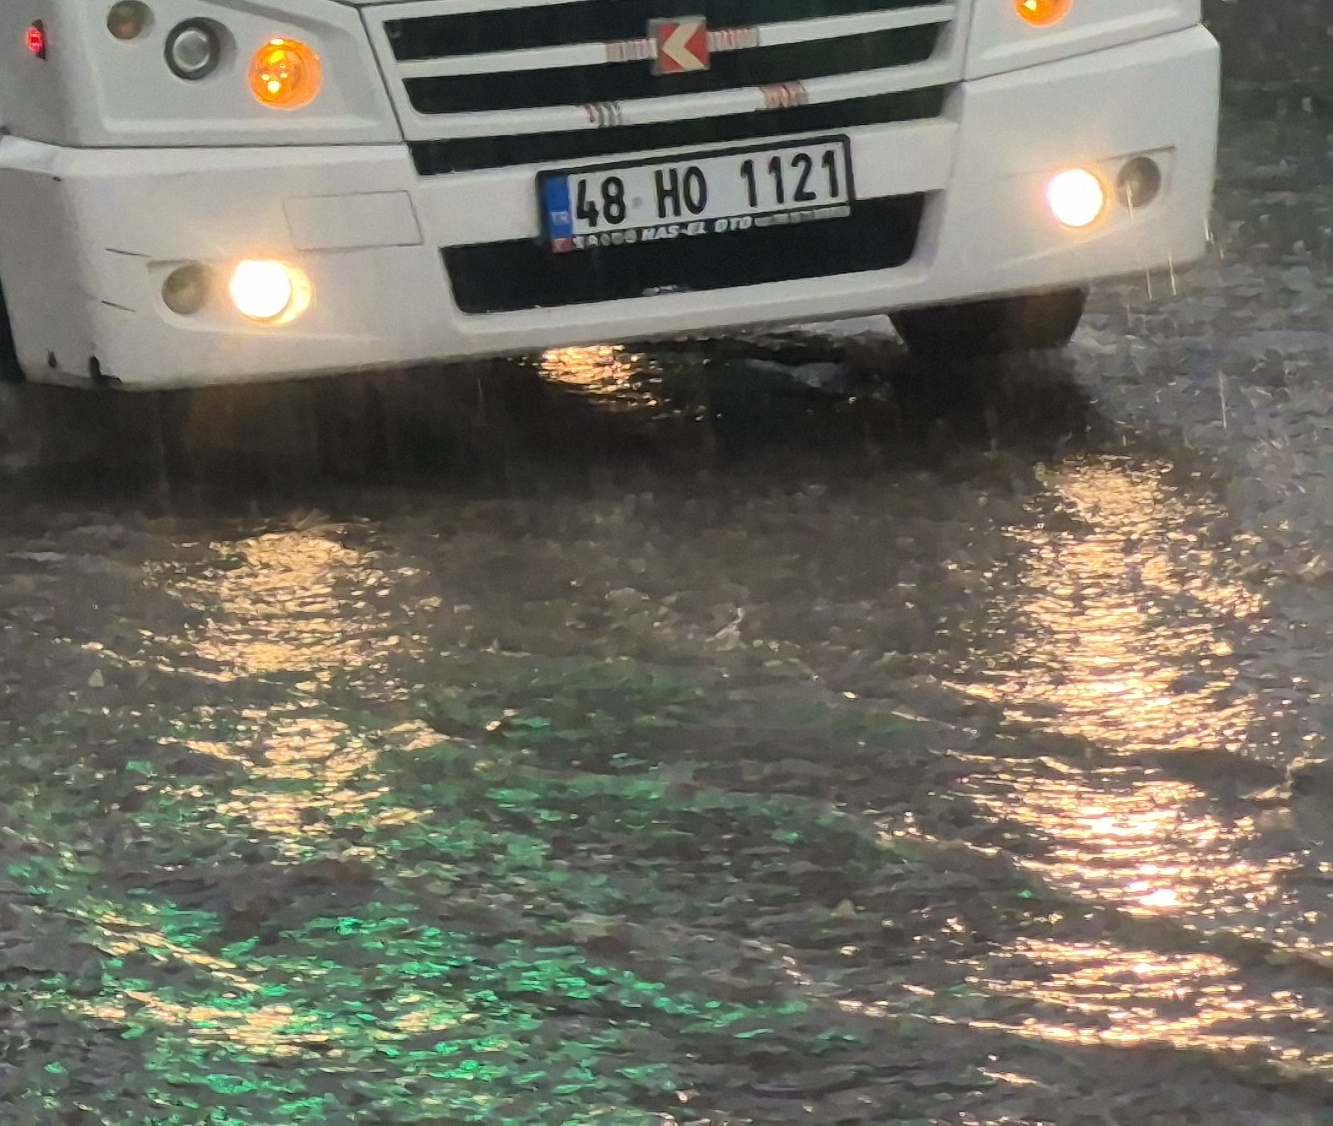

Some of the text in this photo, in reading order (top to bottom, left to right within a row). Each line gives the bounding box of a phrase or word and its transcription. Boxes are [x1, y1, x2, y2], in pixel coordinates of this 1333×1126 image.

[576, 150, 840, 228] 48 HO 1121
